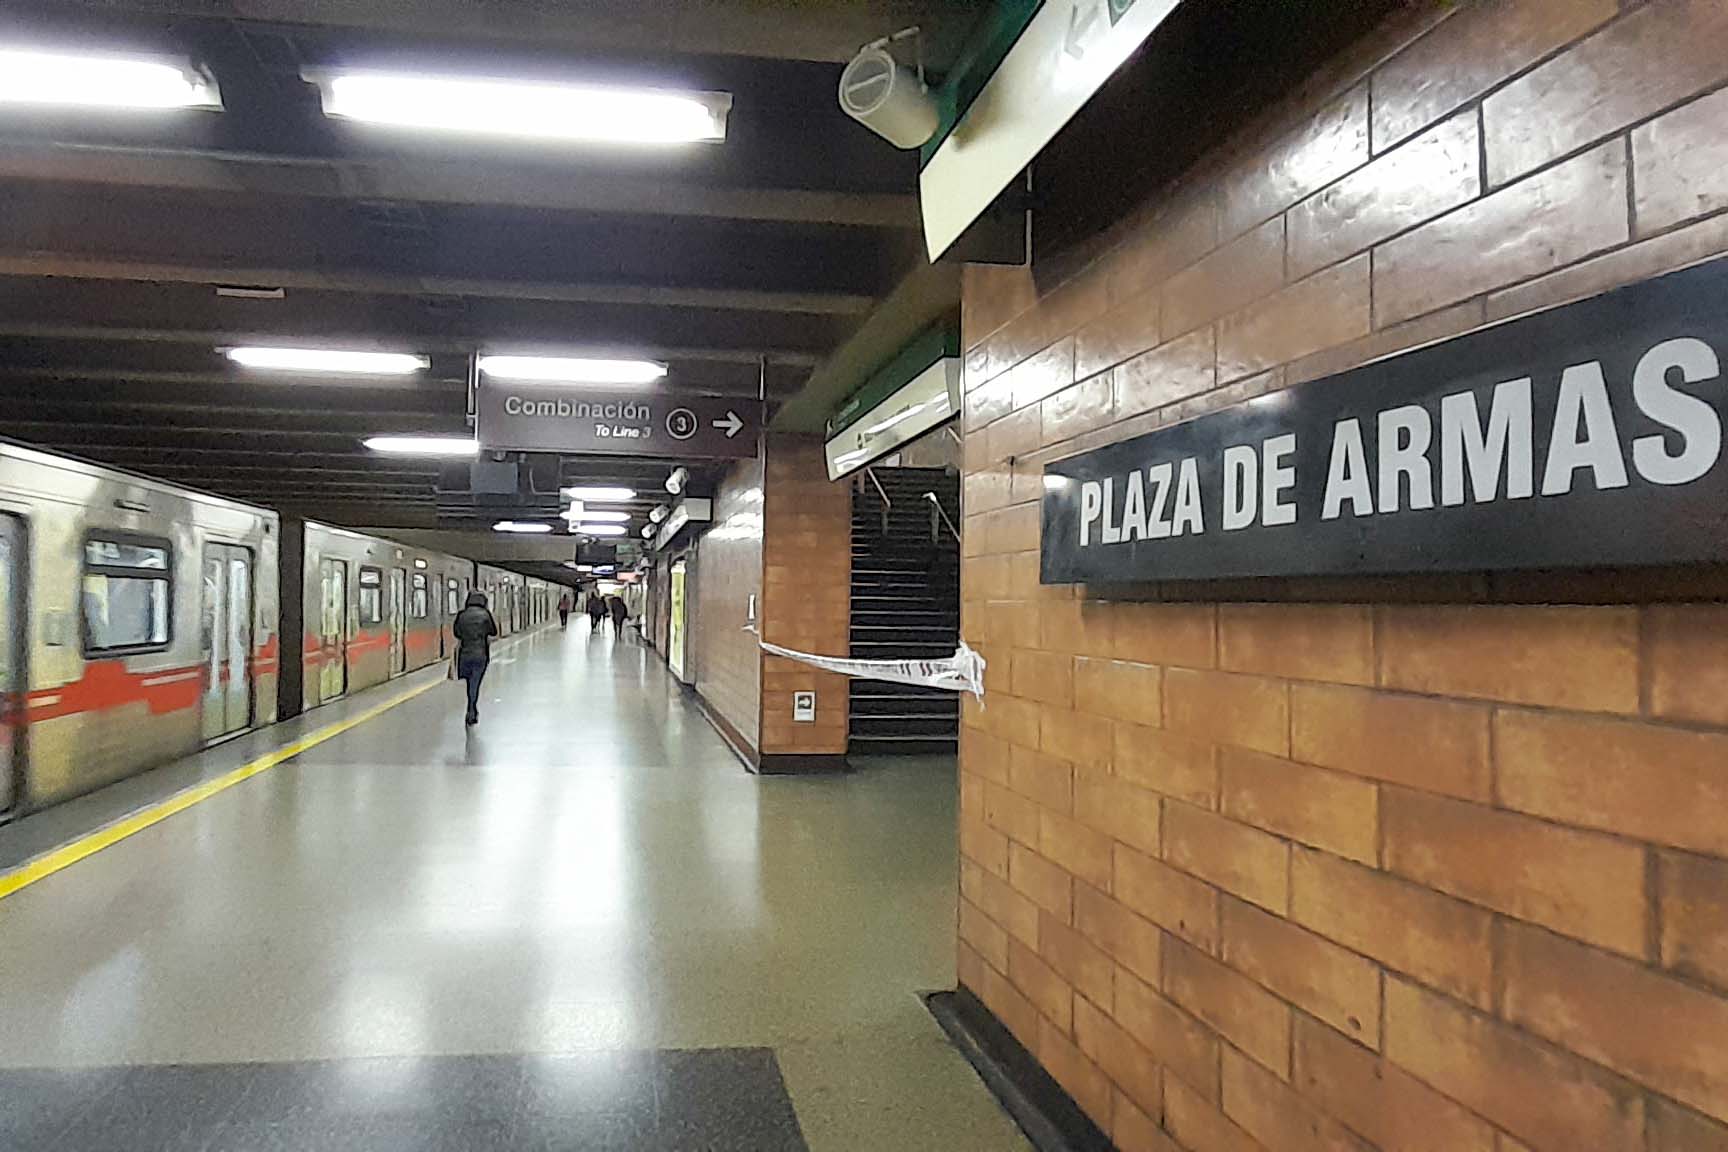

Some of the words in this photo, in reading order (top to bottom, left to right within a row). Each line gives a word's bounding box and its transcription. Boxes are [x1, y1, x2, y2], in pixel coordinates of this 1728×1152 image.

[504, 396, 651, 420] Combinación
[594, 423, 610, 437] To
[612, 425, 640, 439] Line
[642, 428, 651, 439] 3
[675, 416, 687, 432] 3
[1079, 457, 1204, 547] PLAZA
[1222, 434, 1298, 531] DE
[1320, 337, 1722, 520] ARMAS
